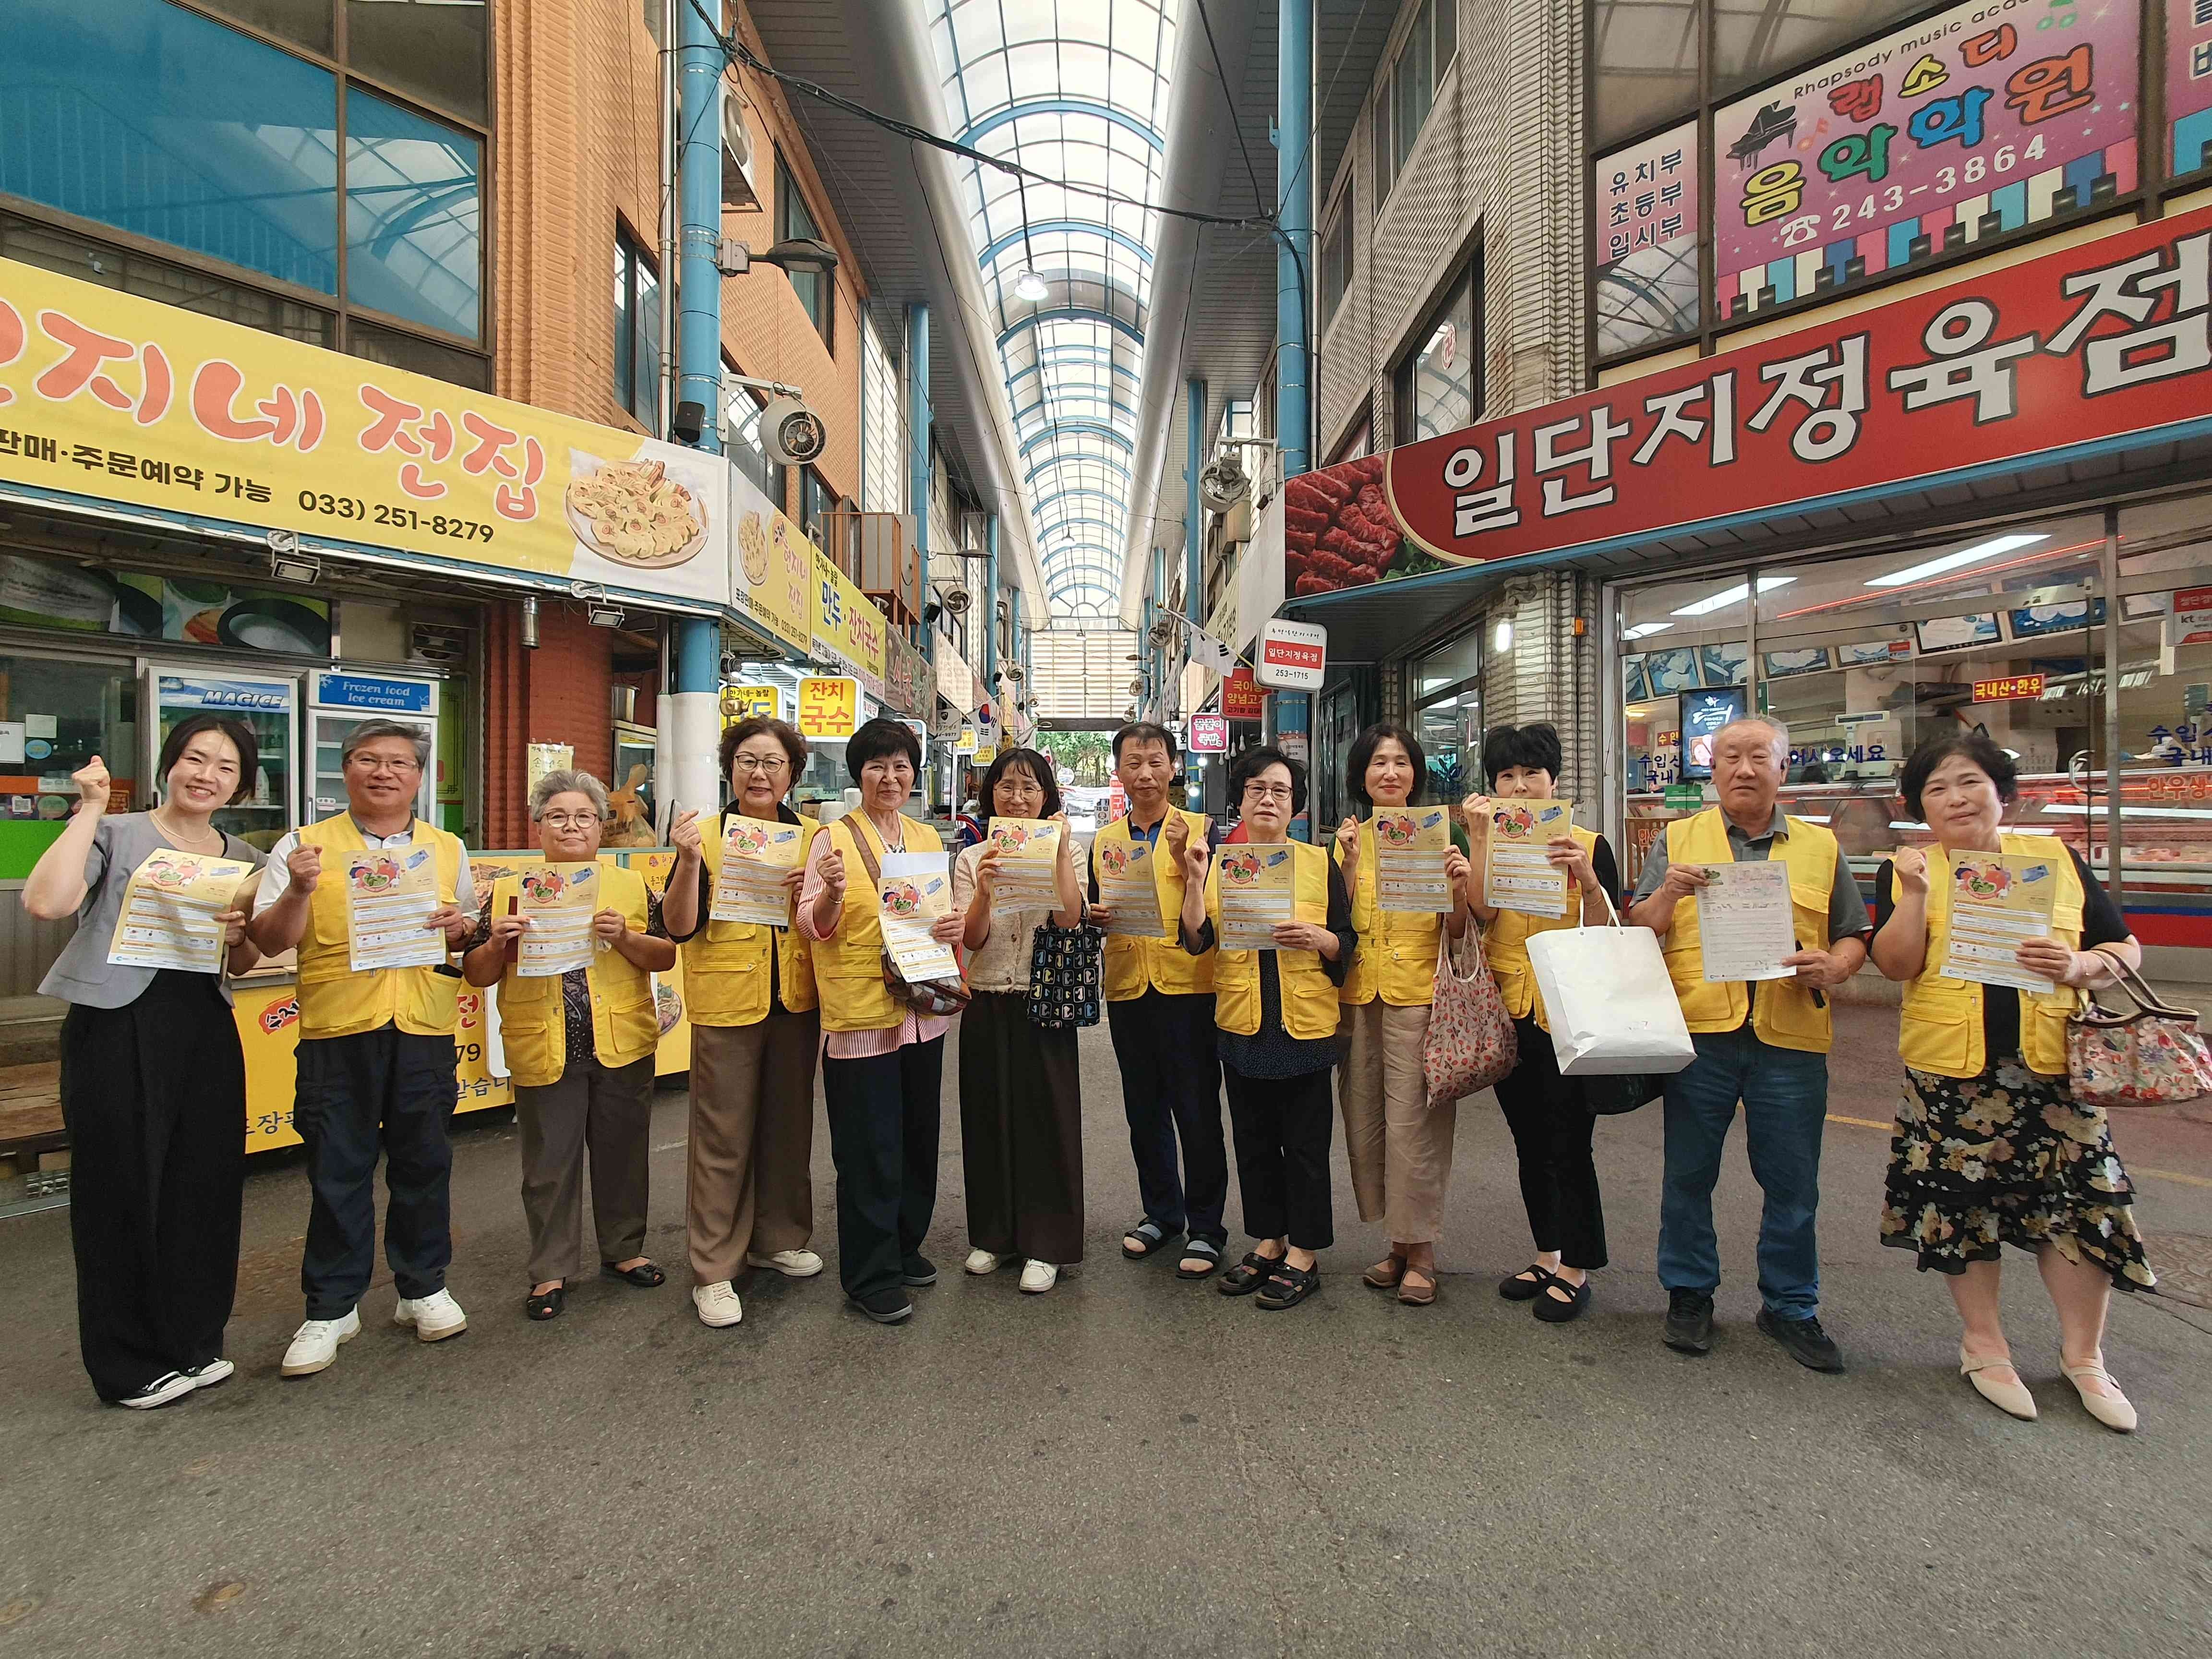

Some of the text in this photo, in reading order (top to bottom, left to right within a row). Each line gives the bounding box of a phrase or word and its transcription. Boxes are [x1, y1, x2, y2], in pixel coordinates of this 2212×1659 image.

[1794, 50, 1892, 99] Rhapsody
[1900, 21, 1962, 54] music
[1827, 22, 2018, 123] 랩소디
[1609, 148, 1683, 196] 유치부
[1832, 133, 2047, 231] 243-3864
[1610, 180, 1683, 228] 초등부
[1610, 213, 1683, 260] 입시부
[1443, 232, 2211, 538] 일단지정육점
[358, 383, 546, 522] 전집
[215, 473, 272, 504] 가능
[299, 490, 366, 521] 033)
[374, 504, 494, 543] 251-8279
[822, 580, 842, 632] 만두
[849, 606, 879, 661] 잔치국수
[1268, 648, 1318, 662] 일단지정육점
[1275, 669, 1309, 680] 253-1715
[343, 681, 410, 697] Frozen food
[348, 693, 405, 706] Ice cream
[810, 682, 844, 701] 잔치
[801, 706, 852, 733] 국수
